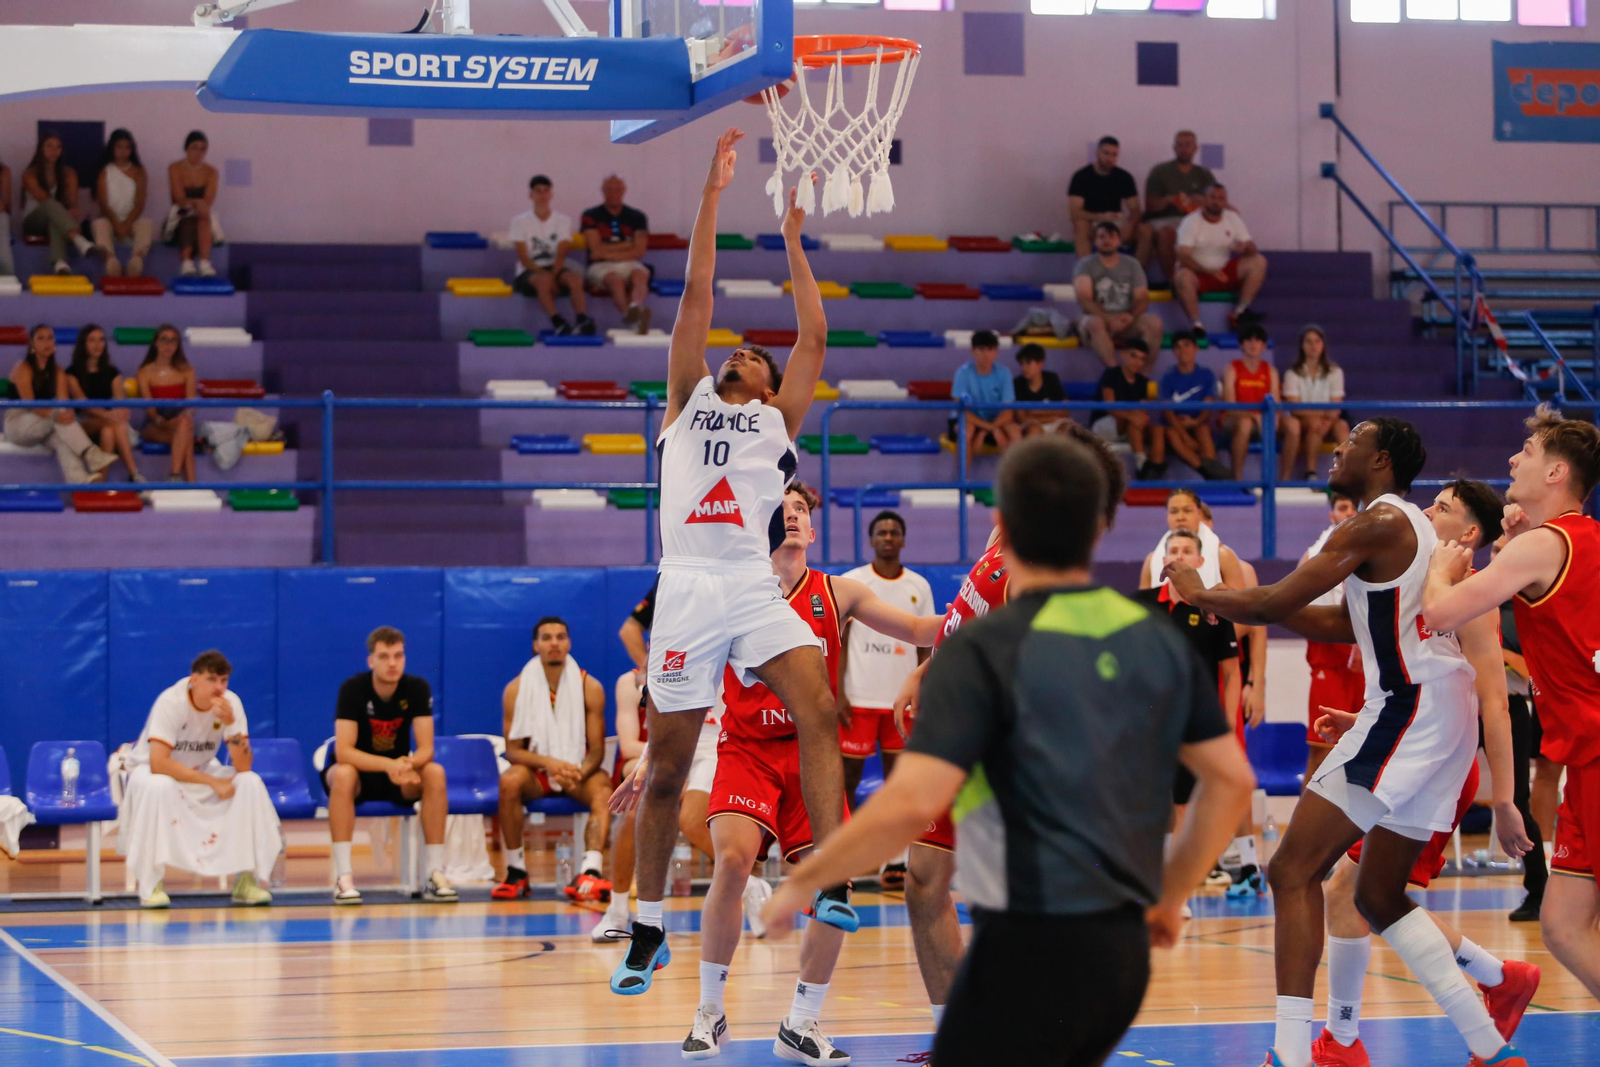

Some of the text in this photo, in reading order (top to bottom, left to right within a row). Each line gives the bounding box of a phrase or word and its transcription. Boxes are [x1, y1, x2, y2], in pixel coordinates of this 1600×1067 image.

[690, 410, 760, 433] FRANCE
[703, 439, 730, 466] 10
[694, 500, 739, 518] MAIF
[865, 642, 892, 654] ING
[728, 794, 756, 809] ING
